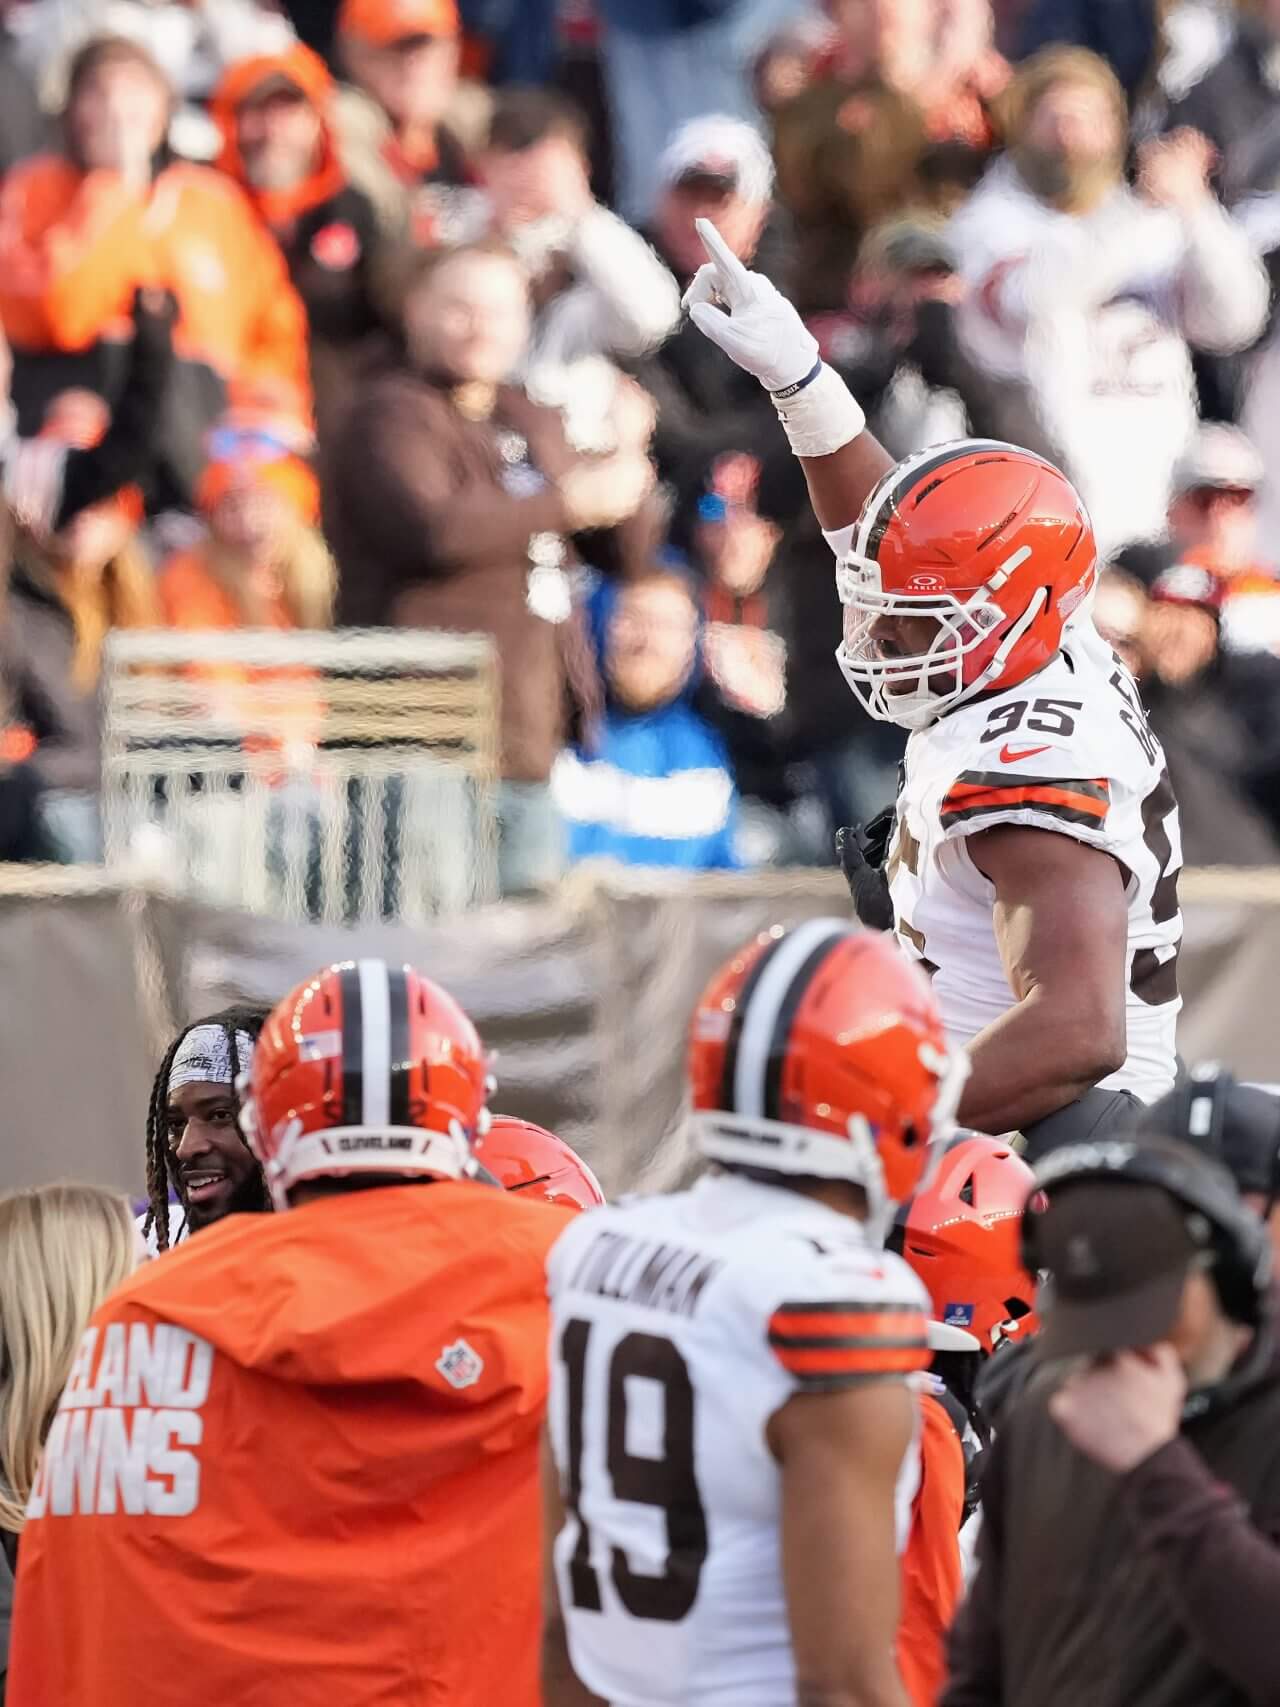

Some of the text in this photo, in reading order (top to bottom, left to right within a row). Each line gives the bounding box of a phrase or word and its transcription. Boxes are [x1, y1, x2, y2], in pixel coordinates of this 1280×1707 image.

[980, 698, 1083, 744] 95
[340, 1136, 412, 1150] CLEVELAND
[562, 1317, 709, 1622] 19
